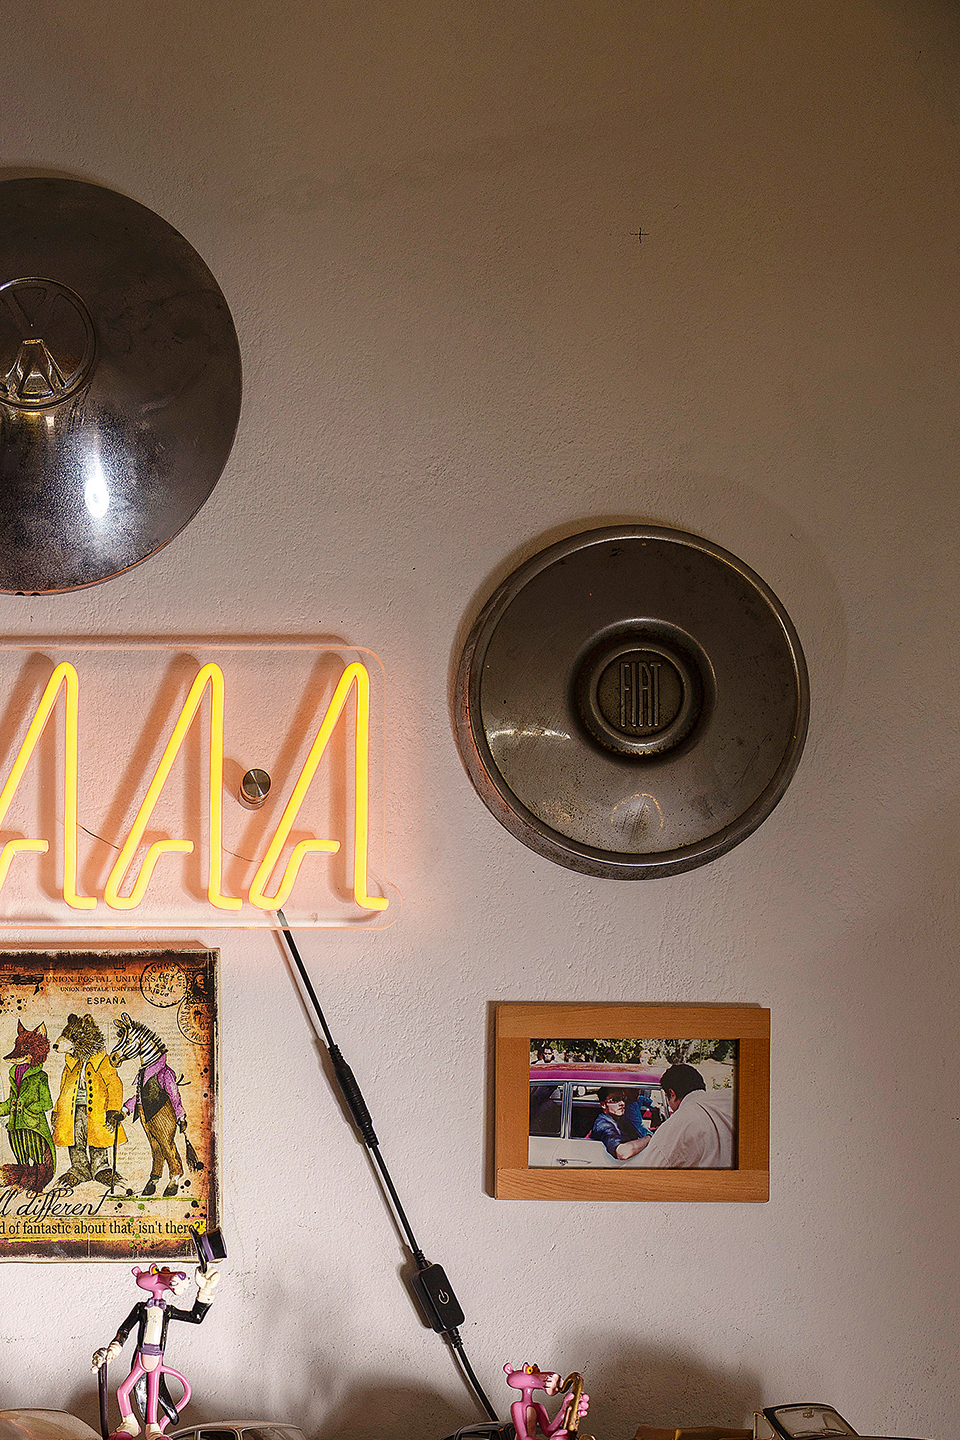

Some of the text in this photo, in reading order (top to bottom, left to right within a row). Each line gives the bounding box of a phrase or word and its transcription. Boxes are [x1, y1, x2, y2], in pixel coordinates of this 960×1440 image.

[618, 660, 663, 728] FIAT
[45, 975, 74, 983] UNION
[77, 975, 112, 983] POSTAL
[86, 995, 127, 1005] ESPAÑA
[8, 1221, 22, 1235] of
[23, 1221, 71, 1235] fantastic
[74, 1221, 105, 1235] about
[138, 1221, 162, 1235] isn't
